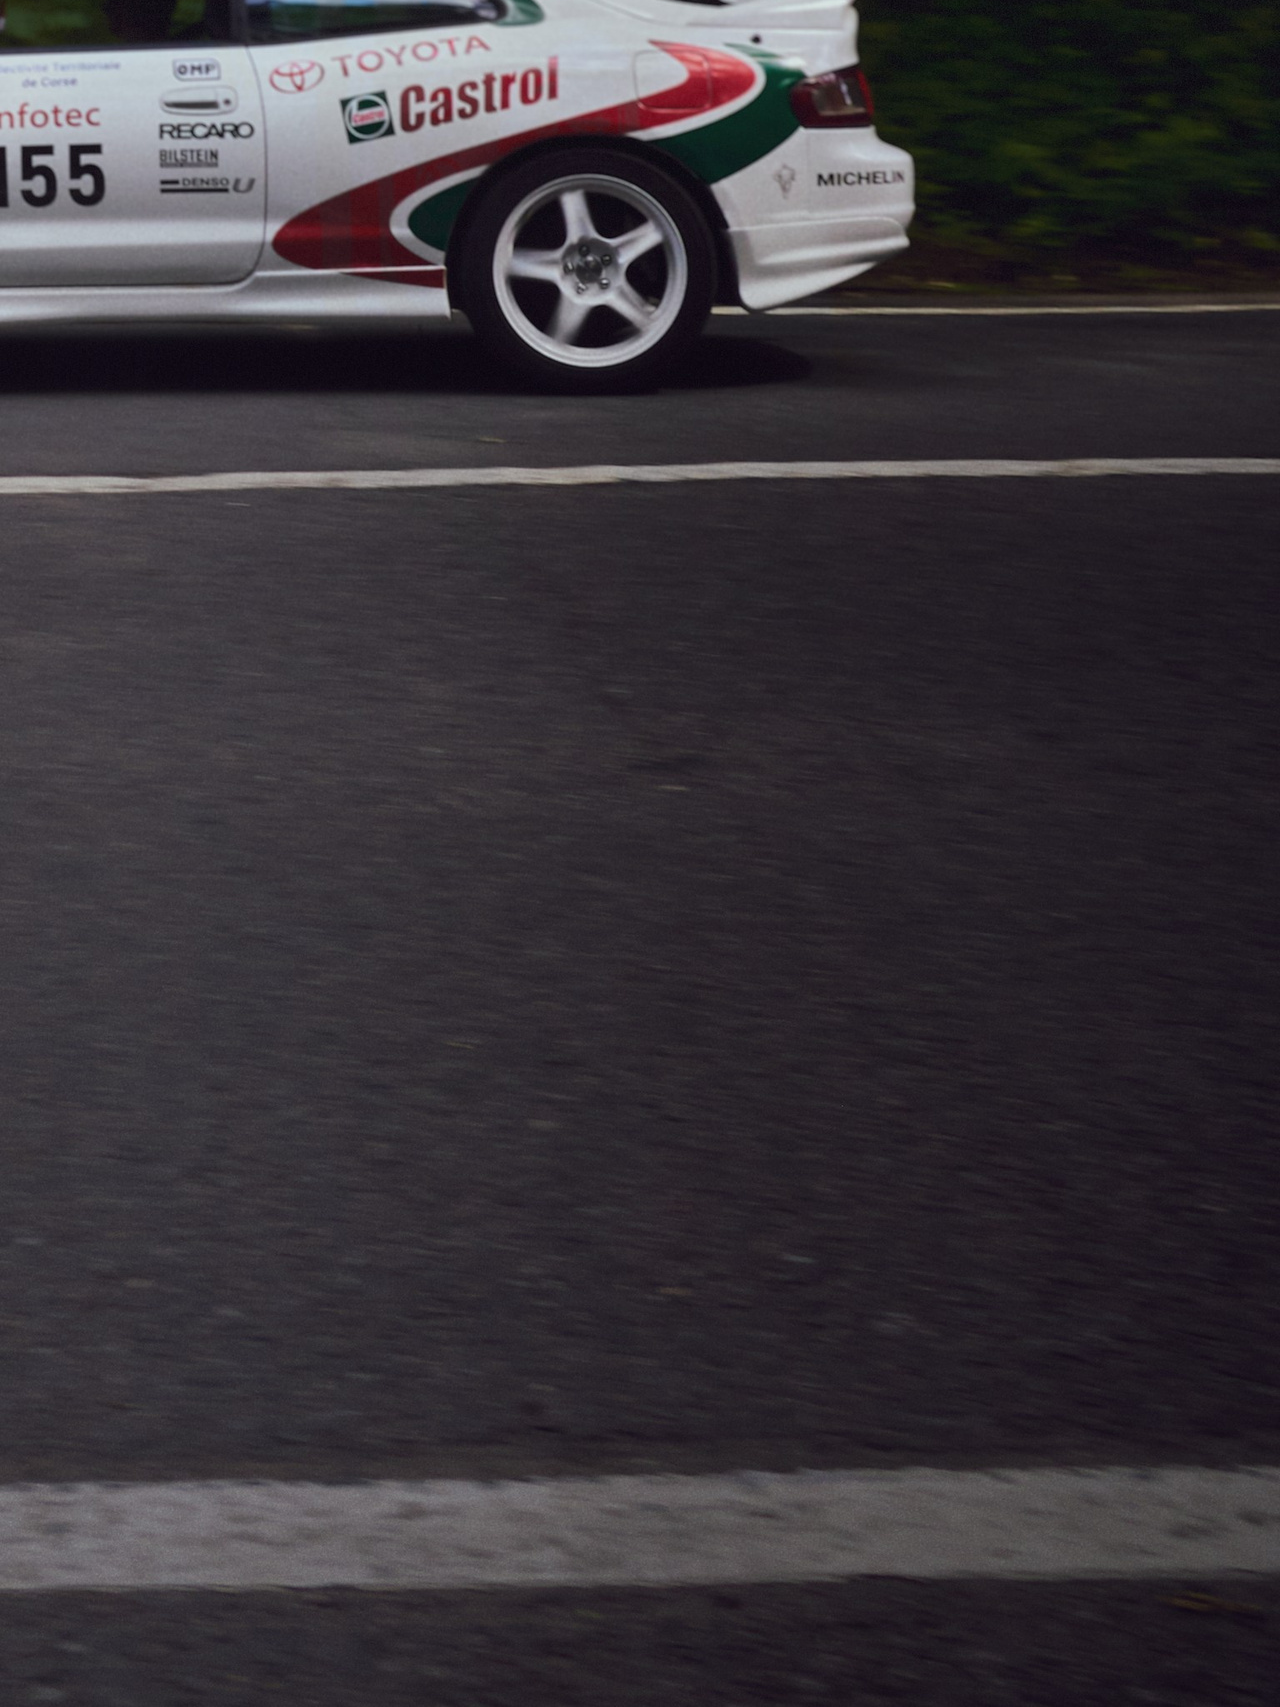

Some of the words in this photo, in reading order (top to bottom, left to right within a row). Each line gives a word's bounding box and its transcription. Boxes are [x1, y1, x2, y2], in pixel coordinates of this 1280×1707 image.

[332, 35, 492, 77] TOYOTA
[177, 63, 216, 75] OMP
[400, 56, 558, 133] Castrol
[159, 122, 255, 139] RECARO
[159, 149, 219, 162] BILSTEIN
[182, 177, 229, 187] DENSO
[816, 170, 905, 187] MICHELIN
